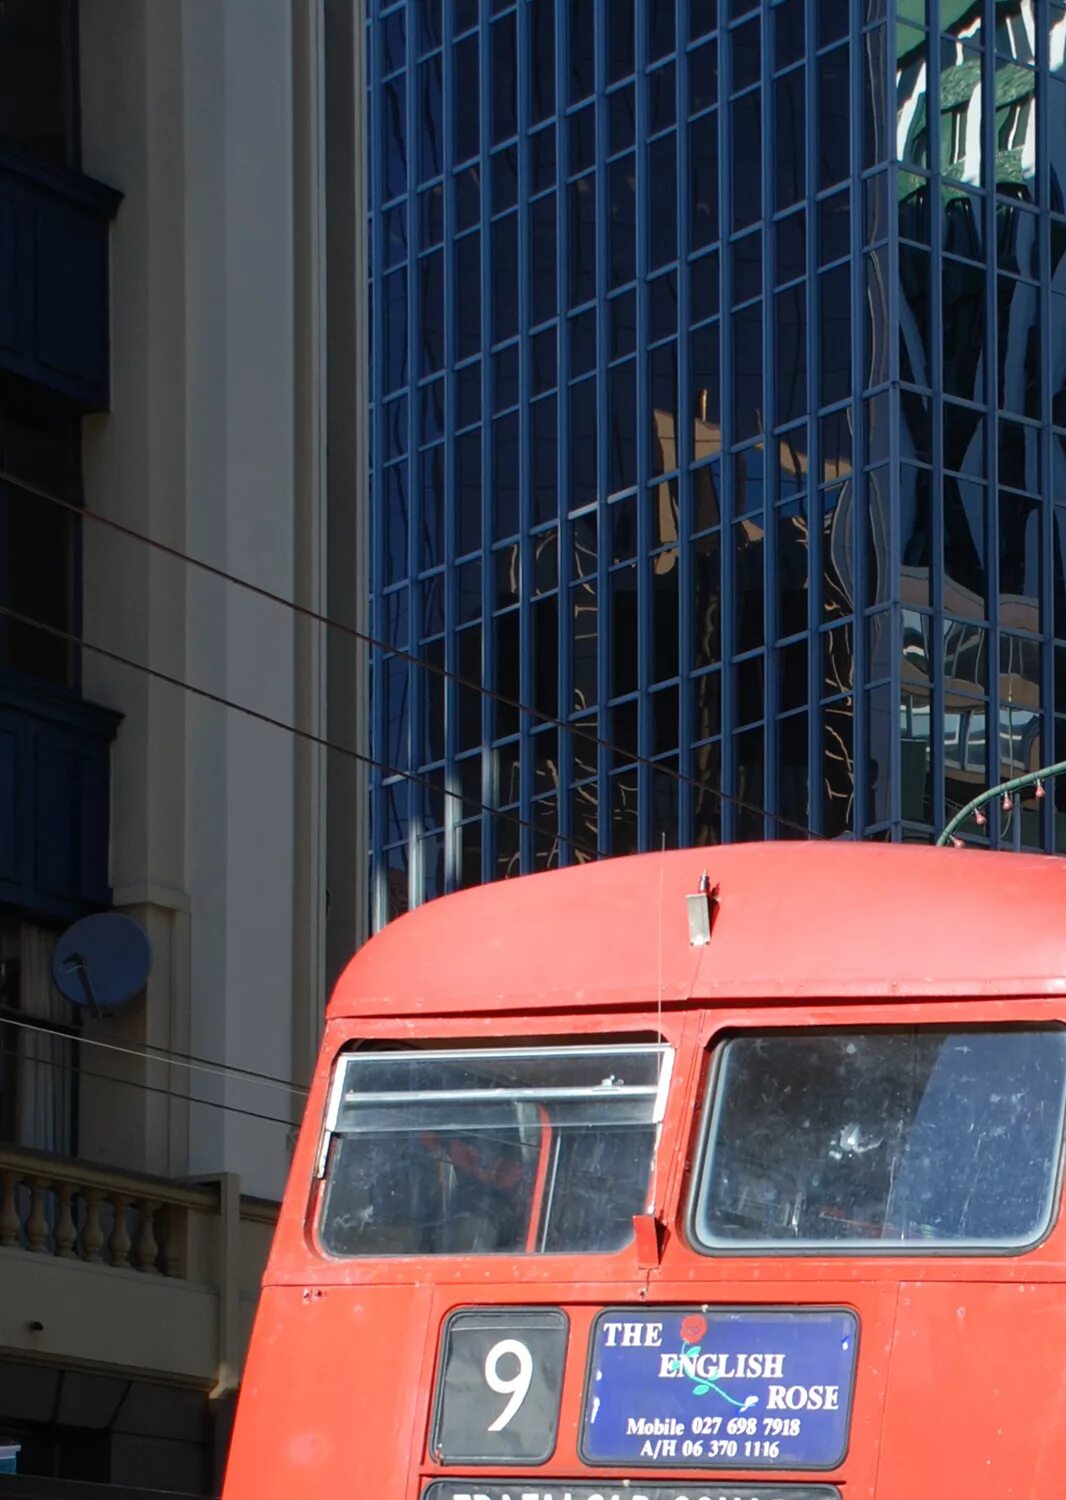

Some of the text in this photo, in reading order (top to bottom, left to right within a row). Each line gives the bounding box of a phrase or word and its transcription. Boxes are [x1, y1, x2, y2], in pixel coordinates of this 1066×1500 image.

[603, 1323, 663, 1346] THE
[658, 1353, 786, 1378] ENGLISH
[485, 1339, 534, 1431] 9
[766, 1386, 839, 1411] ROSE
[626, 1416, 801, 1436] Mobile 027 698 7918
[640, 1440, 780, 1460] A/H 06 370 1116
